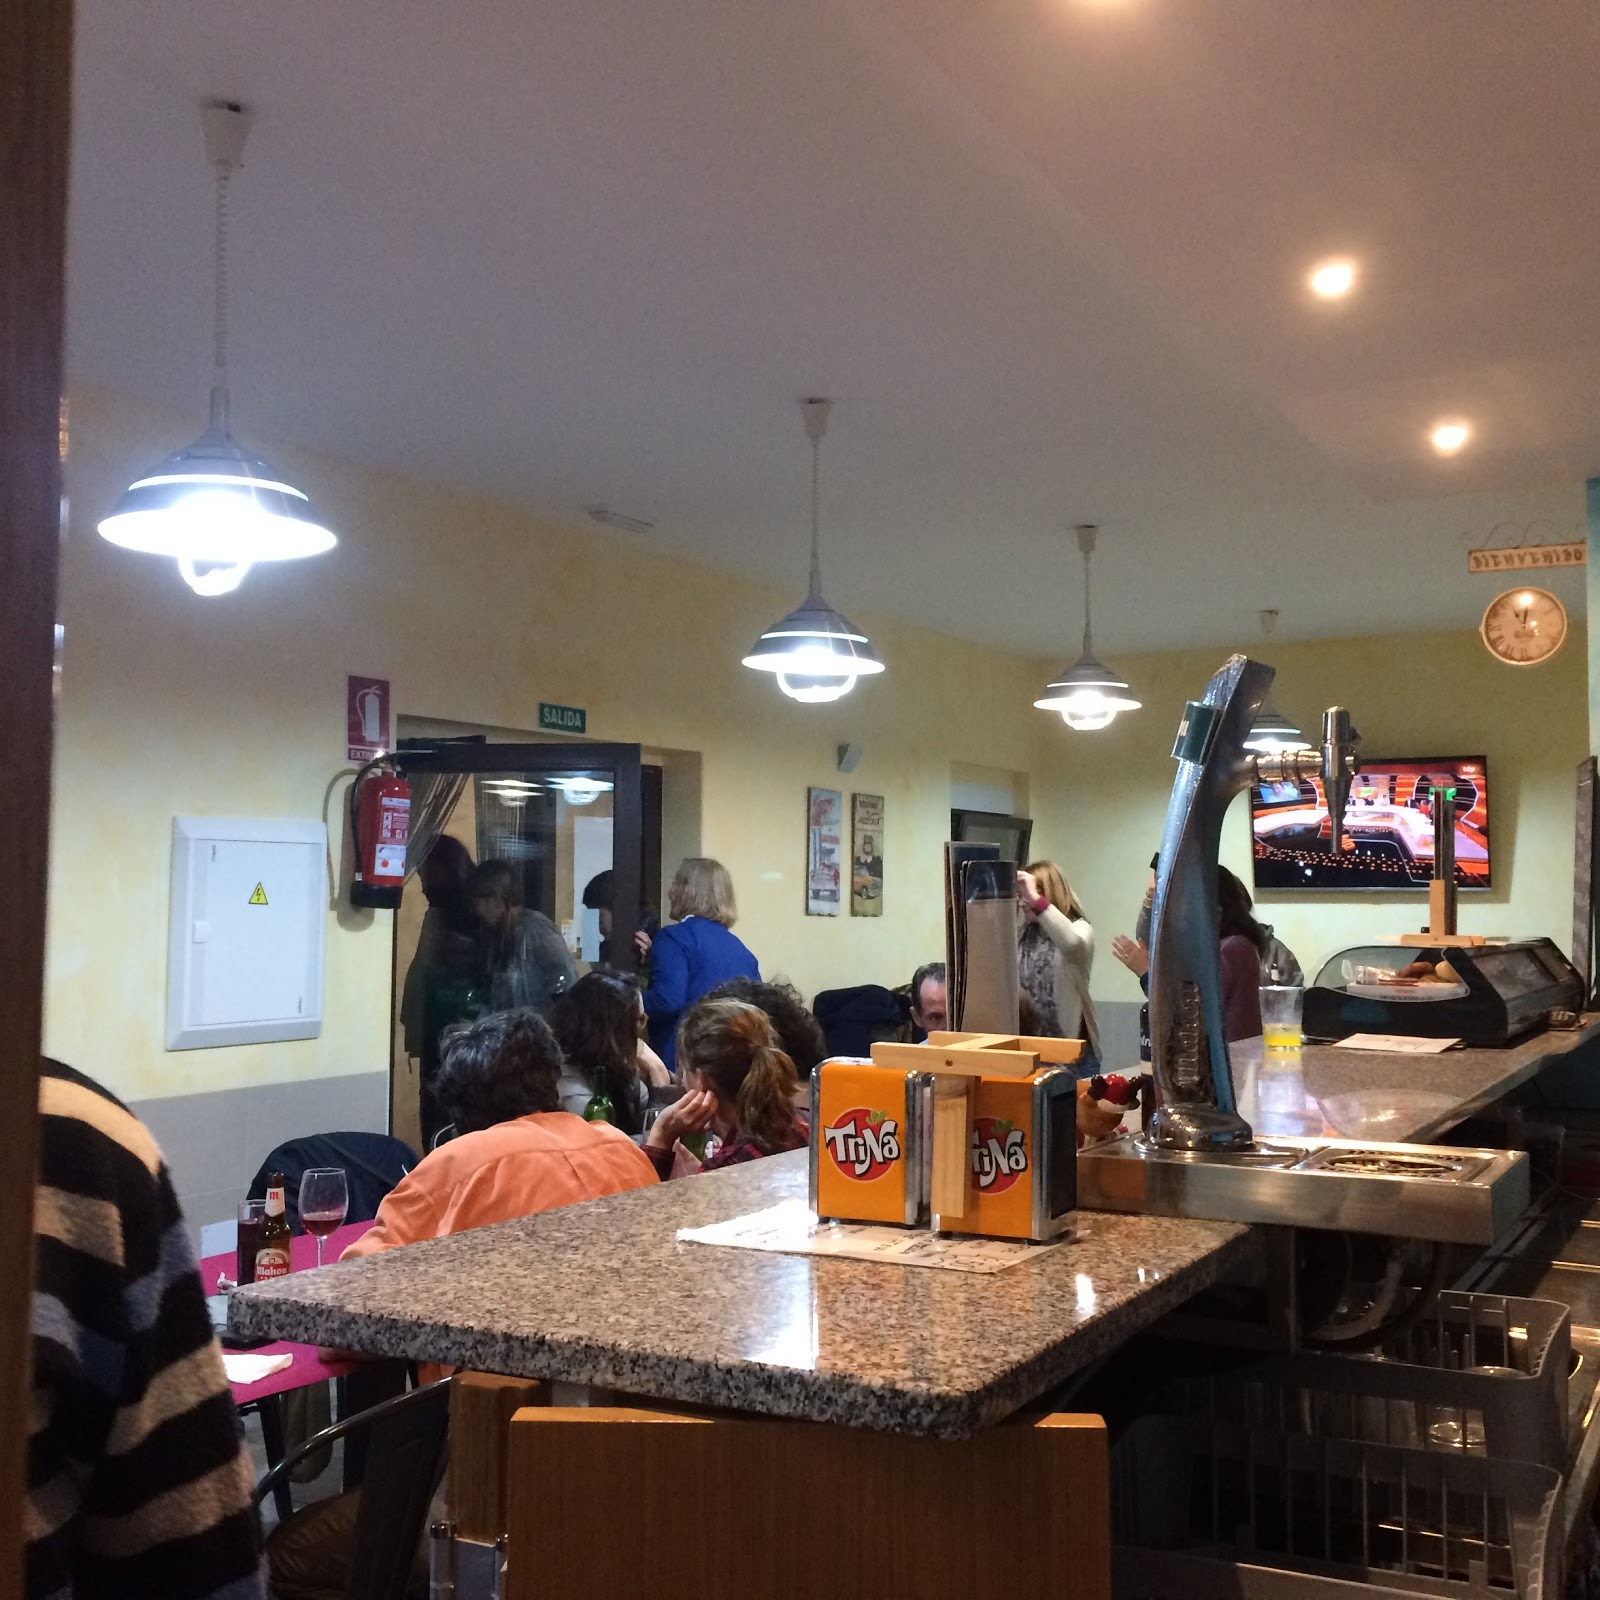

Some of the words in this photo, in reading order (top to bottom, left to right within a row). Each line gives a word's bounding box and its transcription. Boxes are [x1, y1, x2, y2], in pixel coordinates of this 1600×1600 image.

[1473, 548, 1583, 569] BIENVENIDO
[543, 707, 582, 727] SALIDA
[256, 1265, 288, 1276] Mahou
